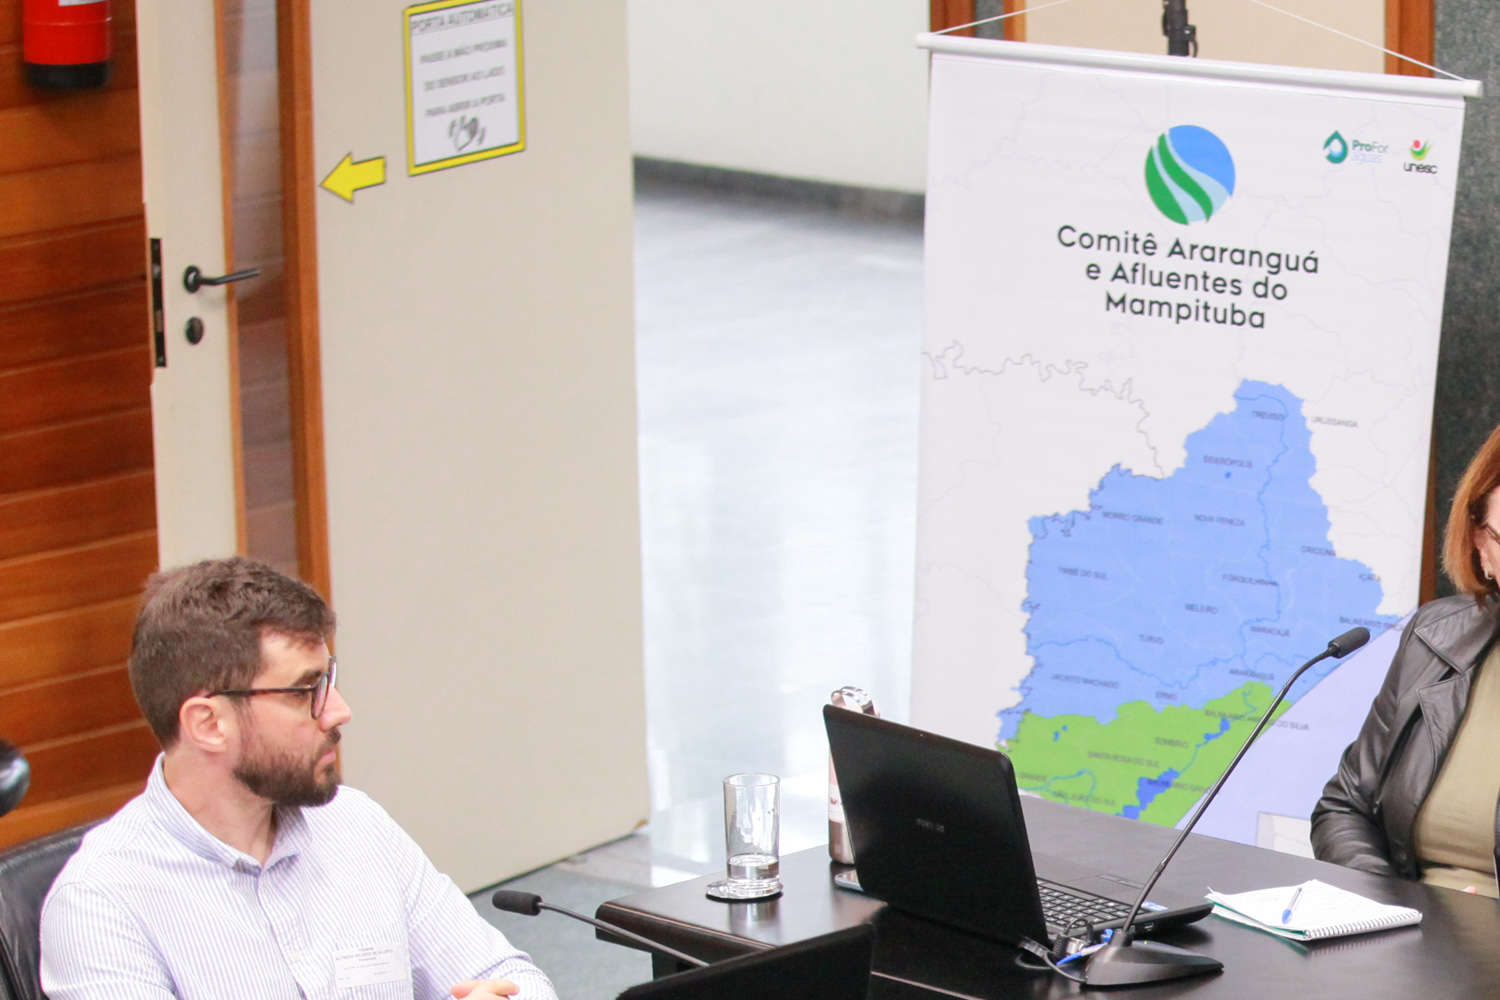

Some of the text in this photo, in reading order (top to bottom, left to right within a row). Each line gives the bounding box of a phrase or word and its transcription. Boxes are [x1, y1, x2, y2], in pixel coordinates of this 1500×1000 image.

[1352, 139, 1389, 154] ProFor
[1403, 162, 1438, 175] unesc
[1057, 225, 1319, 276] Comitê Araranguá
[1085, 261, 1288, 301] e Afluentes do
[1104, 291, 1266, 330] Mampituba
